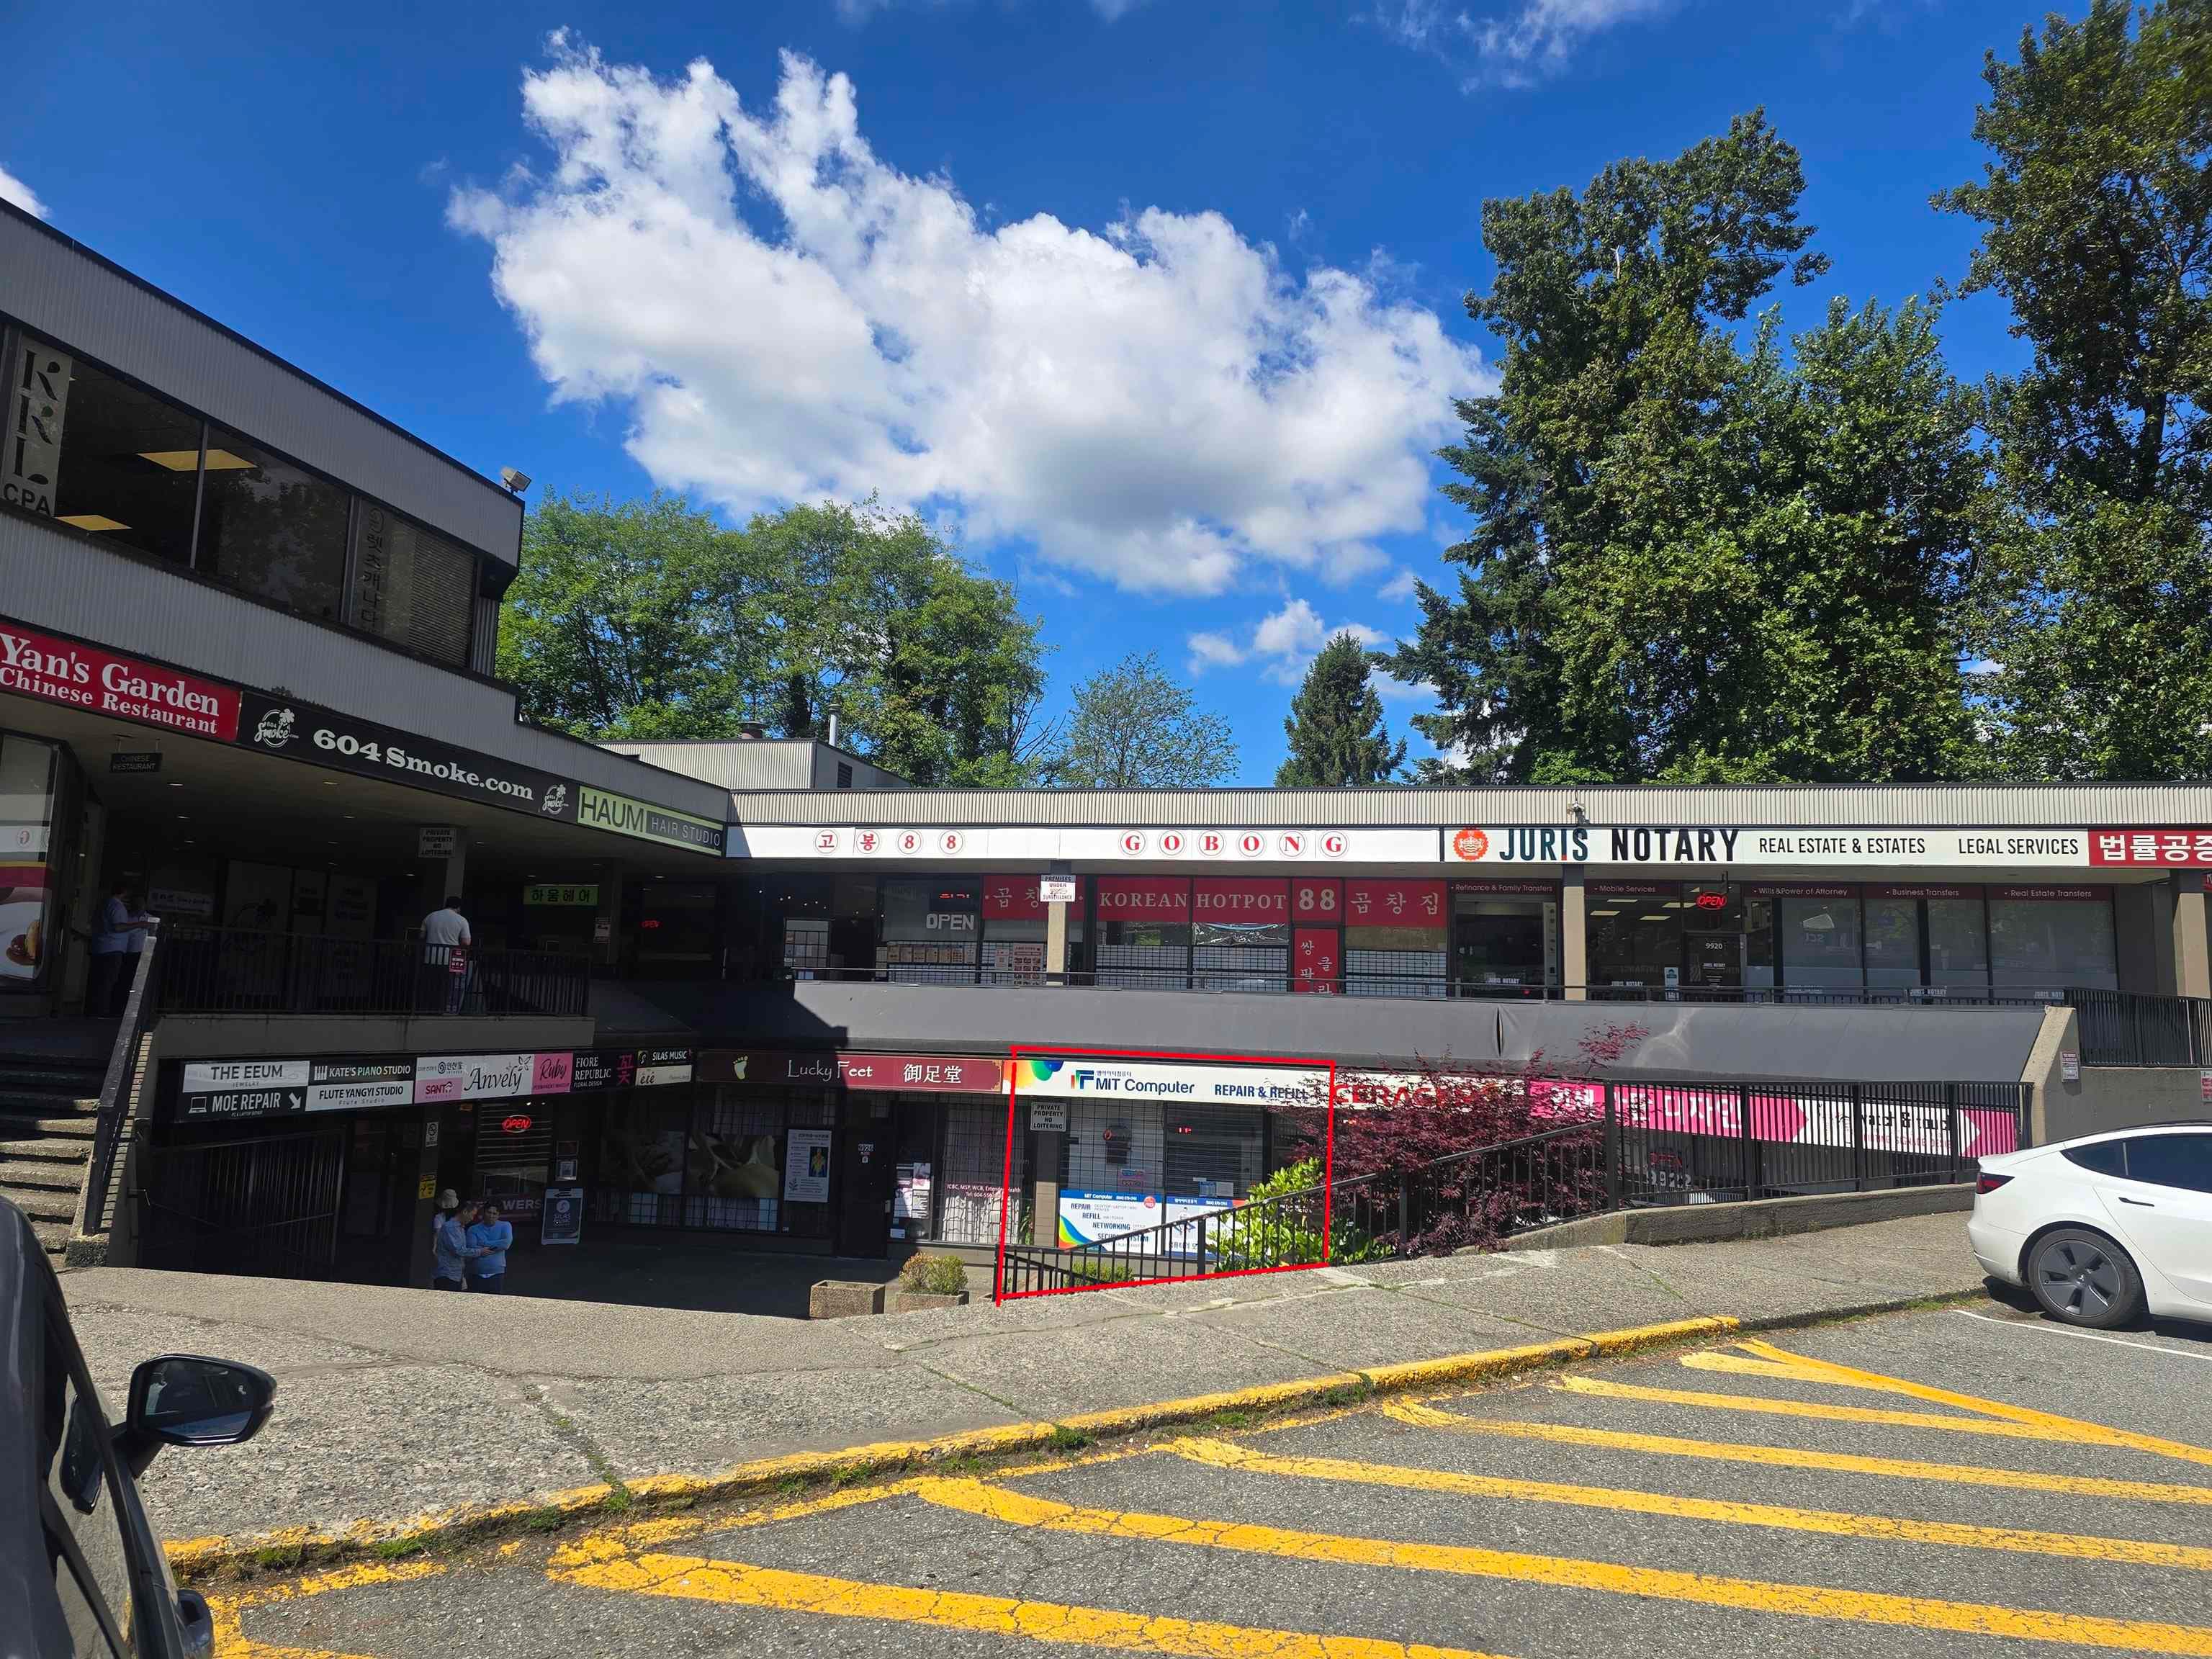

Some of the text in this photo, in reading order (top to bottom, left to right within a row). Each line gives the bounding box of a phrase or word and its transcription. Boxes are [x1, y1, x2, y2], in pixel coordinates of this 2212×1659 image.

[4, 483, 51, 516] CPA
[0, 634, 220, 717] Yan's Garden
[0, 667, 217, 734] Chinese Restaurant
[581, 791, 721, 847] HAUM HAIR STUDIO
[1500, 828, 1588, 862] JURIS
[1611, 828, 1740, 862] NOTARY
[1760, 837, 1794, 854] REAL
[1799, 837, 1848, 855] ESTATE
[1852, 838, 1862, 854] &
[1867, 837, 1925, 855] ESTATES
[1959, 837, 2004, 855] LEGAL
[2008, 837, 2079, 856] SERVICES
[531, 888, 591, 903] 하움헤어
[1456, 884, 1490, 892] Refinance
[1499, 884, 1521, 894] Family
[1522, 884, 1553, 893] Transfers
[1625, 885, 1656, 894] Services
[1815, 888, 1848, 897] Attorney
[1892, 888, 1959, 897] Business Transfers
[2010, 889, 2092, 899] Real Estate Transfers
[1100, 888, 1336, 912] KOREAN HOTPOT 88
[1350, 891, 1441, 916] 곱창집
[1697, 894, 1726, 908] OPEN
[926, 913, 975, 931] OPEN
[576, 1056, 599, 1069] FIORE
[652, 1050, 688, 1061] SILAS MUSIC
[211, 1065, 283, 1080] THE EEUM
[329, 1066, 356, 1077] KATE'S
[357, 1066, 382, 1076] PIANO
[383, 1065, 410, 1076] STUDIO
[540, 1058, 567, 1081] Ruby
[575, 1068, 611, 1081] REPUBLIC
[788, 1059, 873, 1082] Lucky Feet
[902, 1063, 963, 1084] 御足堂
[464, 1064, 522, 1094] Anvely
[319, 1086, 403, 1100] FLUTE YANGYI STUDIO
[1096, 1077, 1120, 1091] MIT
[1124, 1078, 1195, 1096] Computer
[1215, 1084, 1255, 1098] REPAIR
[1257, 1084, 1267, 1098] &
[212, 1092, 282, 1112] MOE REPAIR
[504, 1115, 531, 1130] OPEN
[1092, 1222, 1130, 1231] NETWORKING
